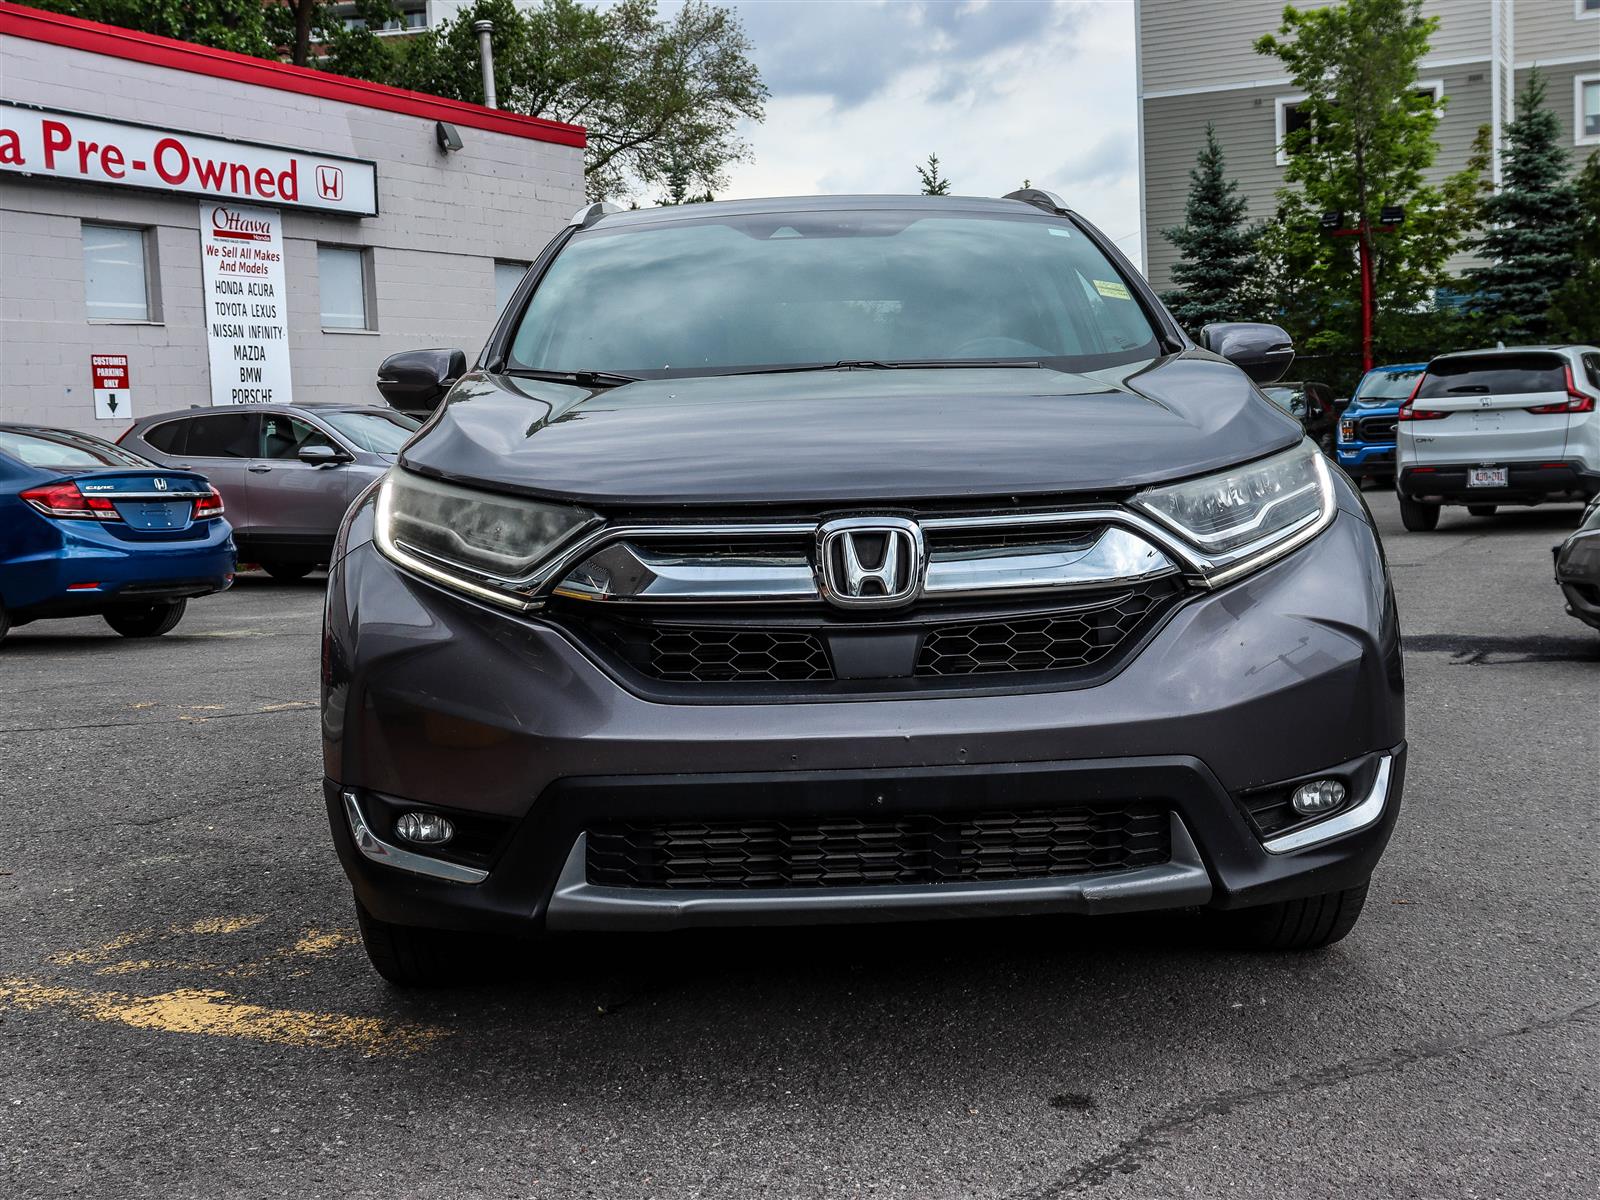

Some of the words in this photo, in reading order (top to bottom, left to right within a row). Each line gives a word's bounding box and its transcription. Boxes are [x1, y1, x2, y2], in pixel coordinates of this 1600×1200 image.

[42, 120, 298, 201] Pre-Owned
[212, 206, 271, 233] Ottawa
[206, 244, 219, 256] We
[221, 246, 238, 258] Sell
[240, 247, 252, 259] All
[254, 249, 281, 262] Makes
[219, 259, 237, 272] And
[238, 261, 269, 274] Models
[215, 279, 244, 295] HONDA
[247, 282, 275, 297] ACURA
[215, 301, 248, 317] TOYOTA
[251, 303, 277, 318] LEXUS
[213, 323, 244, 338] NISSAN
[248, 325, 283, 340] INFINITY
[92, 356, 127, 366] CUSTOMER
[233, 344, 266, 361] MAZDA
[96, 367, 125, 377] PARKING
[240, 366, 262, 382] BMW
[103, 379, 119, 388] ONLY
[231, 388, 273, 404] PORSCHE
